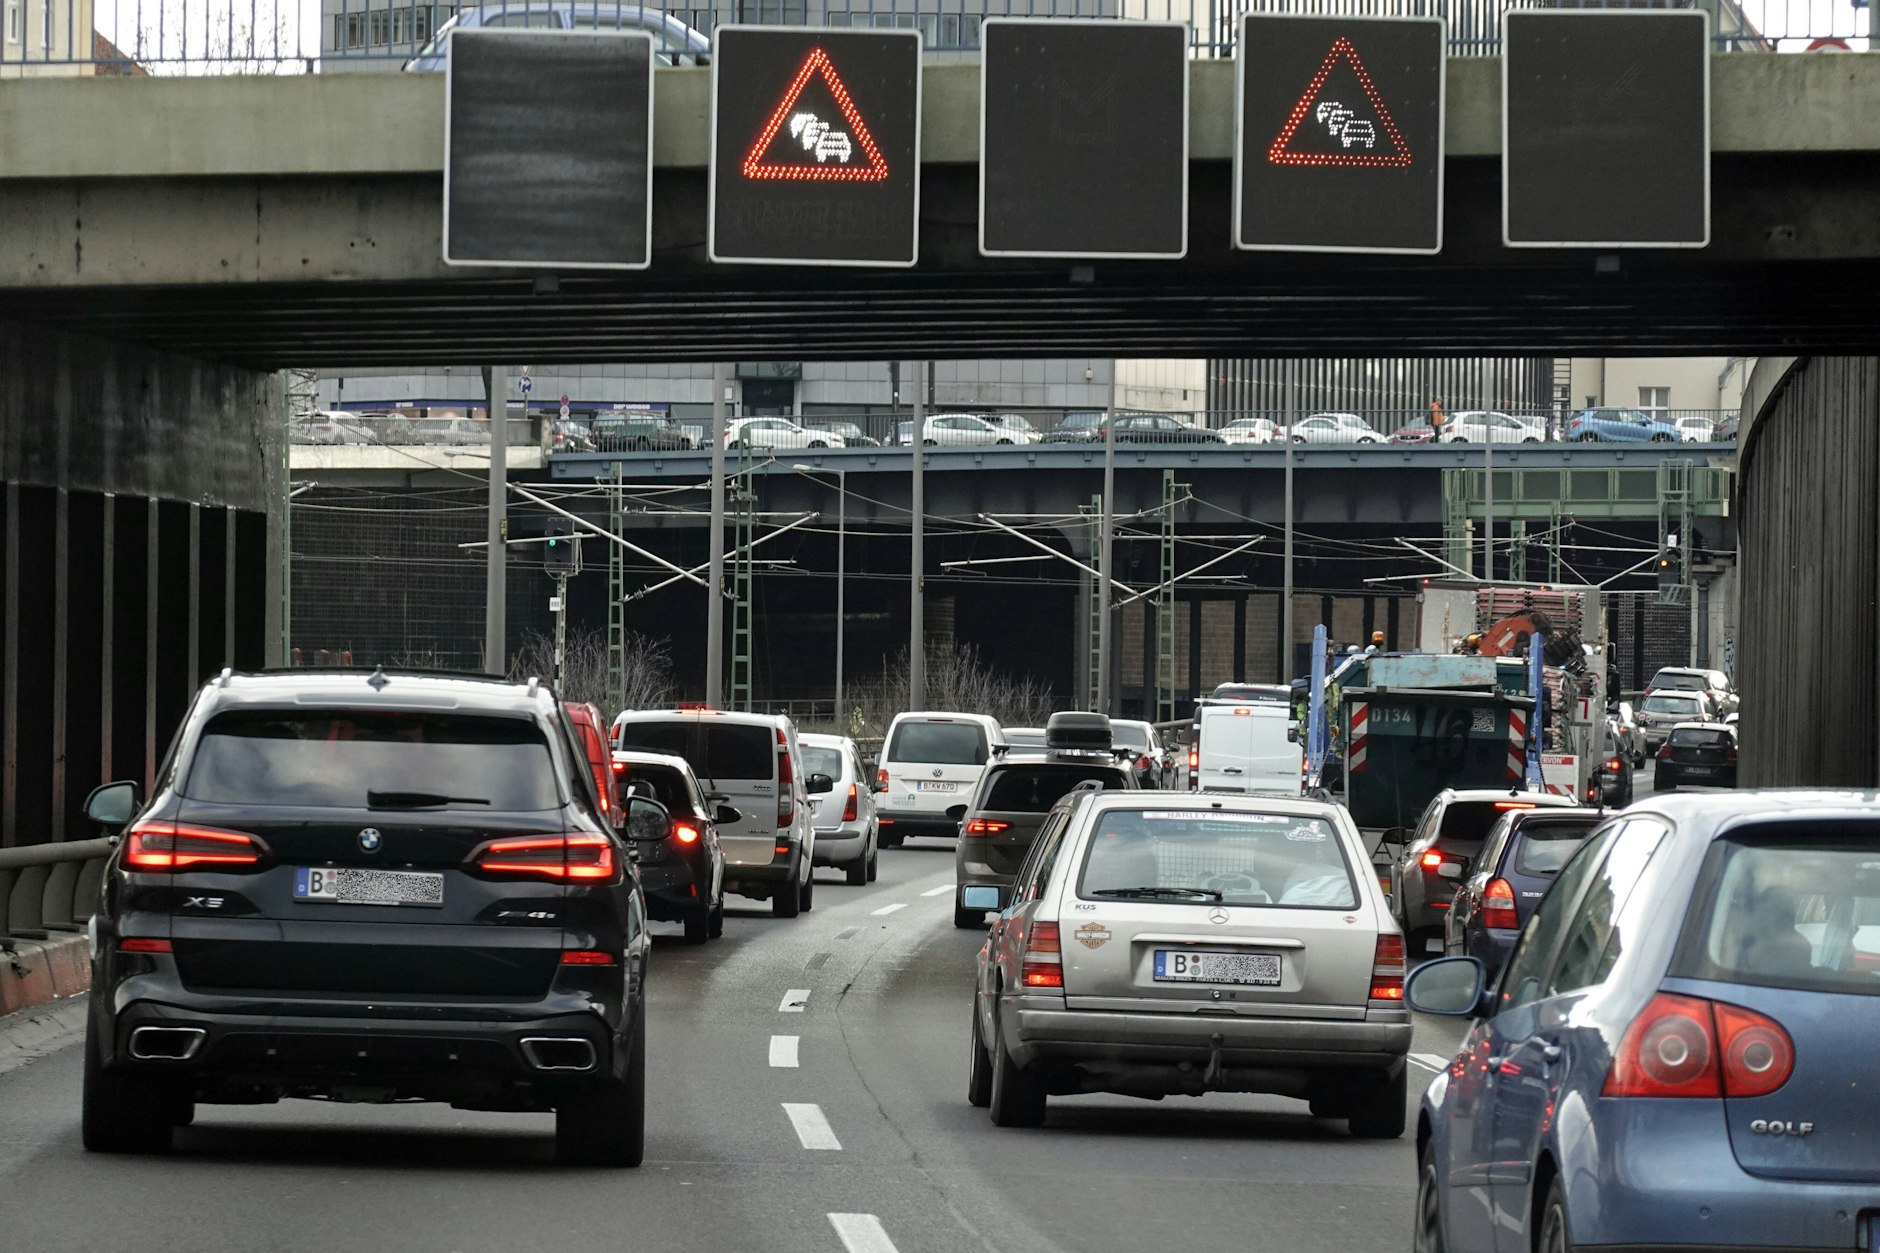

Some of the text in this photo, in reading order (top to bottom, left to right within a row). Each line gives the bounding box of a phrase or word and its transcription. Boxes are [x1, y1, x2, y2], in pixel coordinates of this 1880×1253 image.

[1371, 707, 1411, 723] D134
[310, 871, 323, 894] B
[182, 896, 224, 909] X5
[1174, 954, 1187, 974] B
[1750, 1119, 1814, 1136] GOLF
